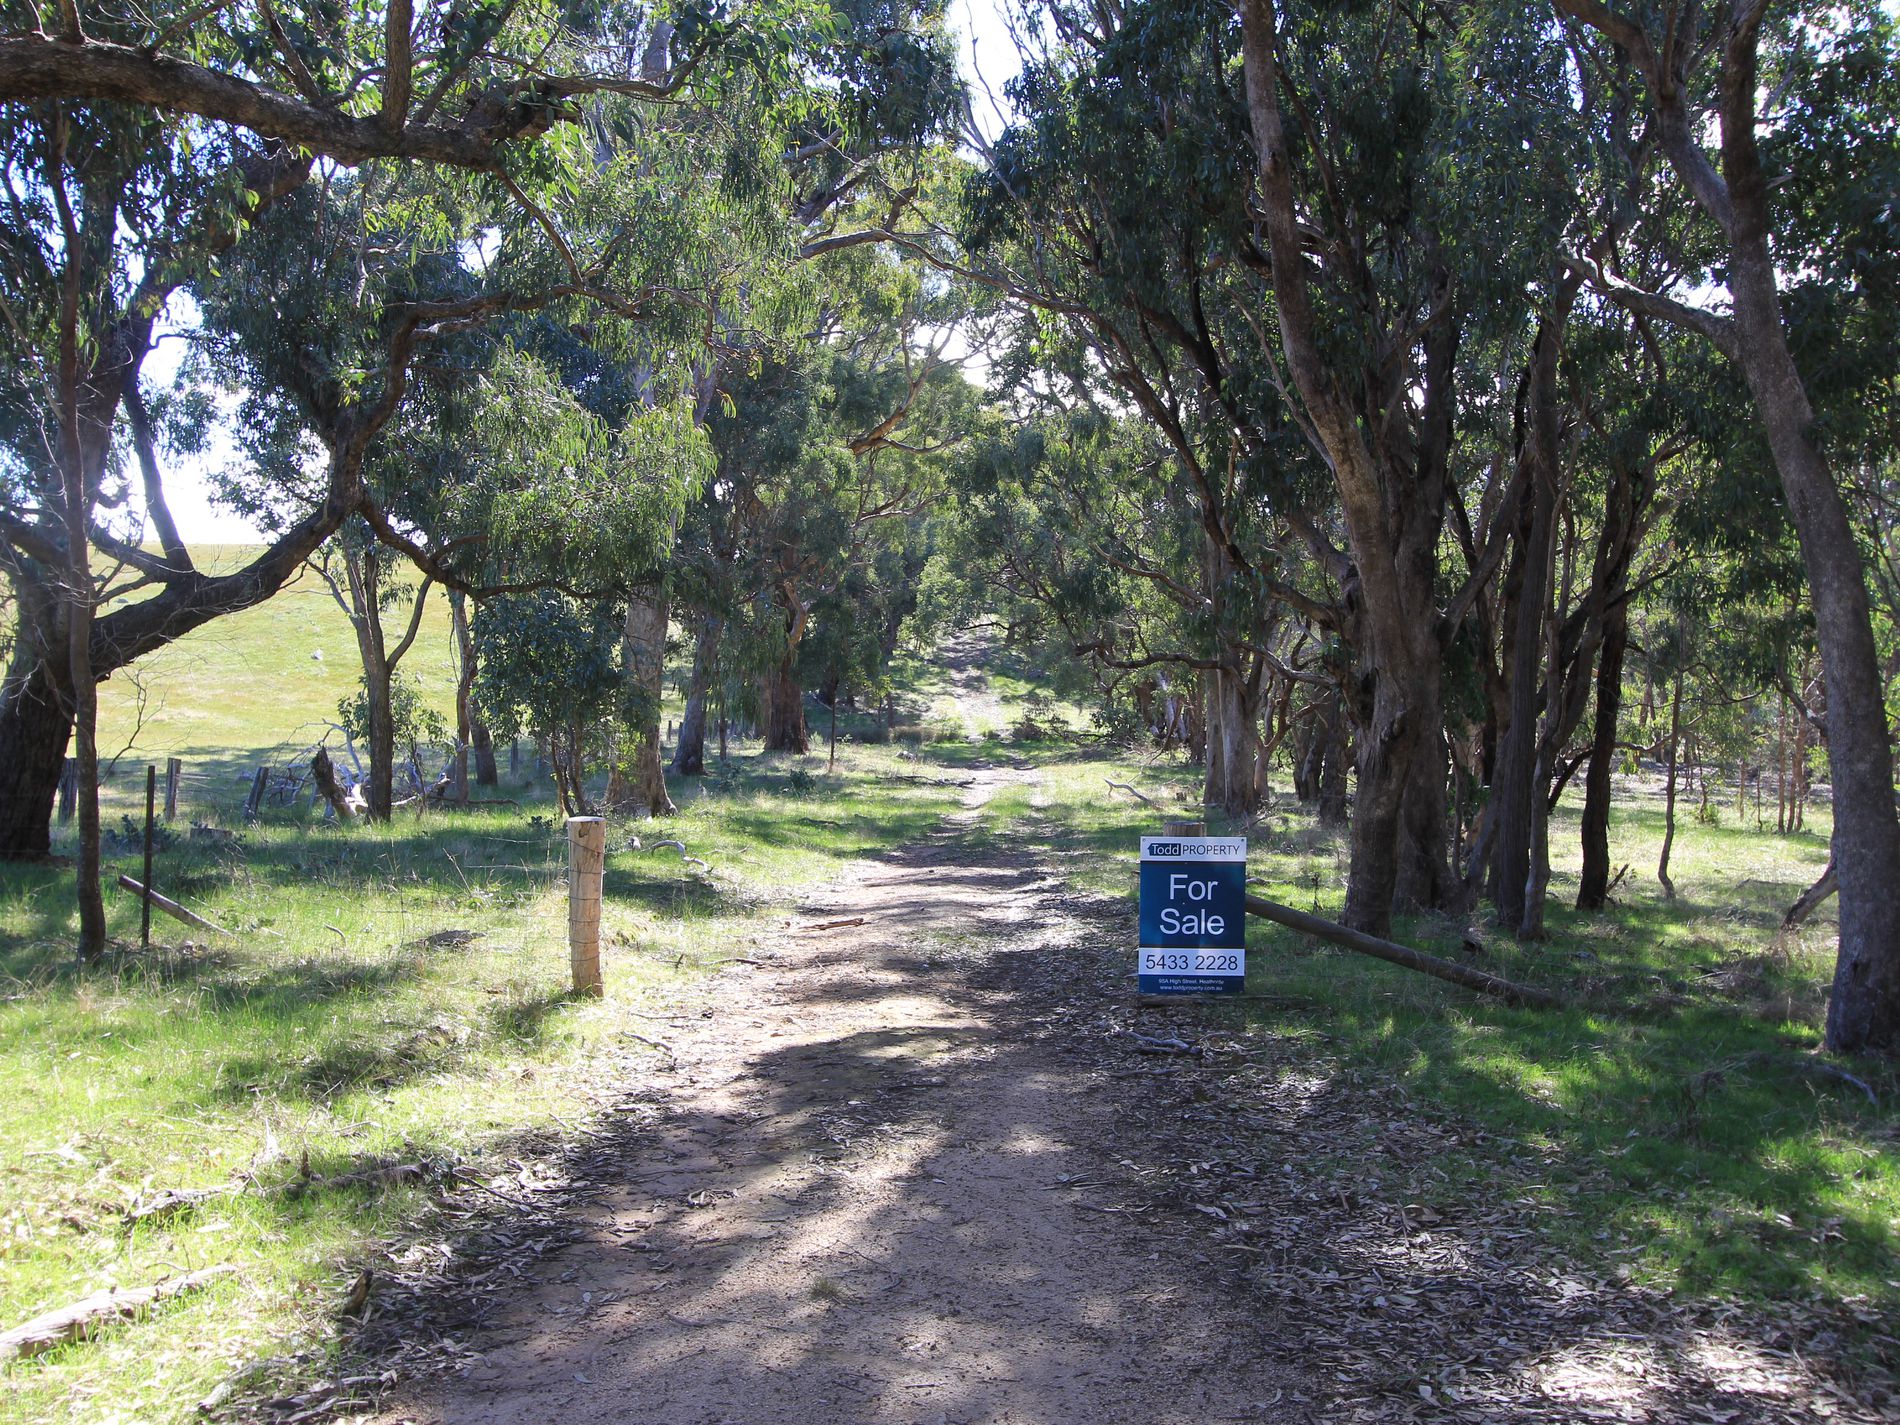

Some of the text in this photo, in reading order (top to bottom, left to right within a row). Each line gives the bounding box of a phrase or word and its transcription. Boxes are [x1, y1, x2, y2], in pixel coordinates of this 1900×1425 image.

[1152, 844, 1240, 855] Todd PROPERTY
[1170, 874, 1219, 900] For
[1160, 908, 1225, 935] Sale
[1145, 954, 1238, 970] 5433 2228
